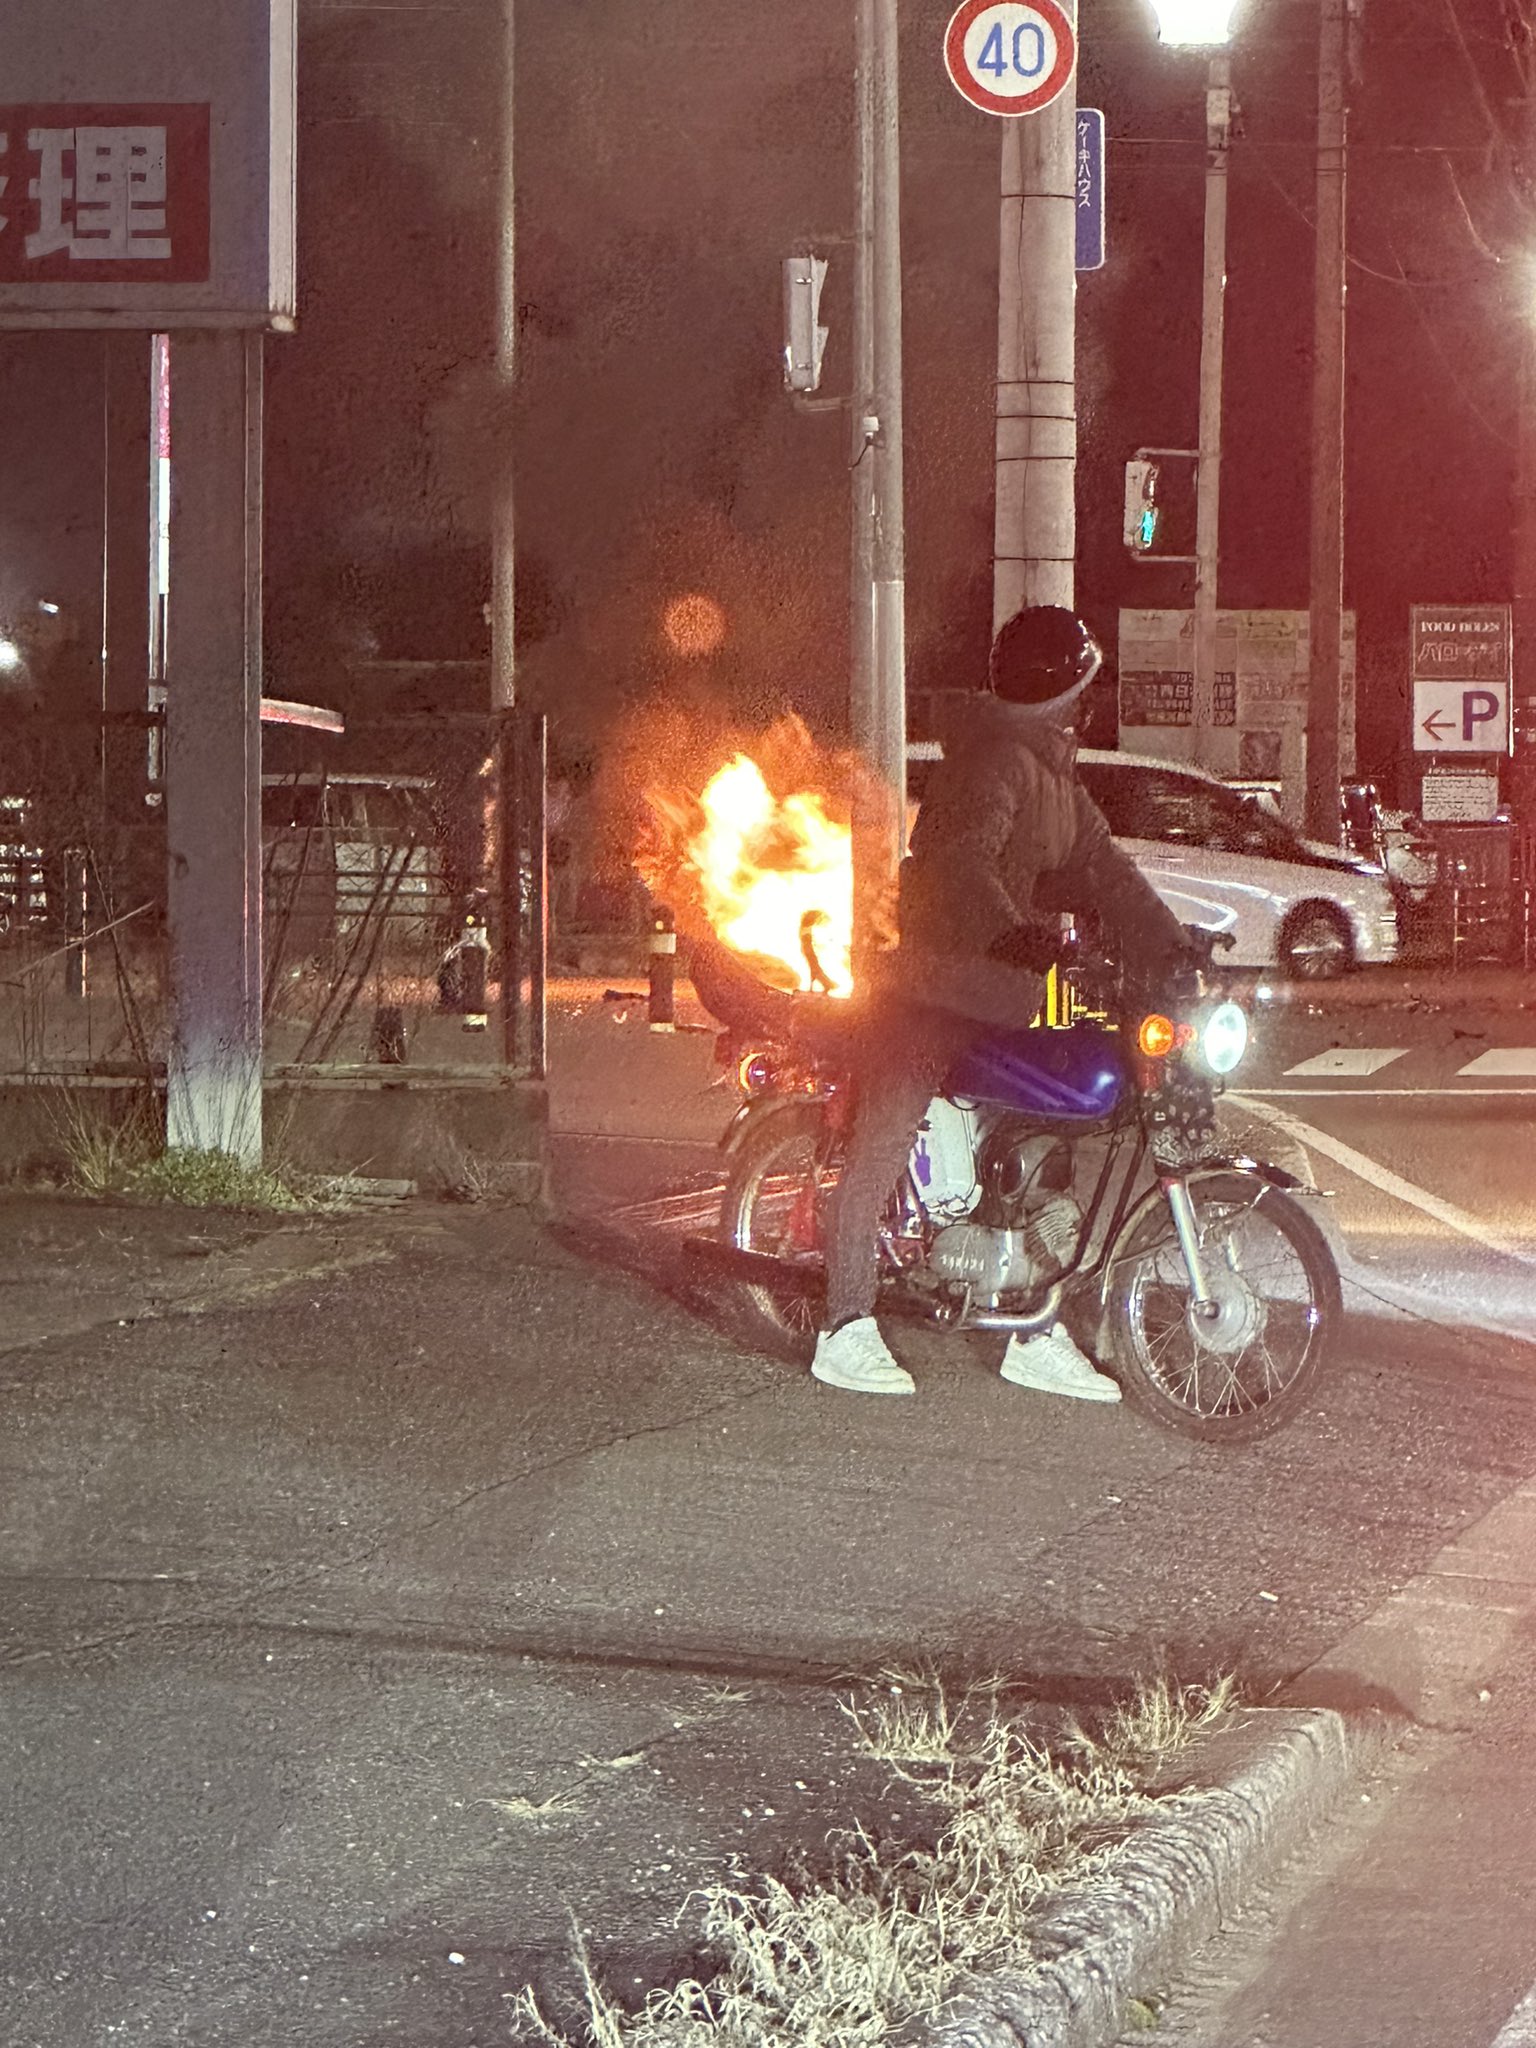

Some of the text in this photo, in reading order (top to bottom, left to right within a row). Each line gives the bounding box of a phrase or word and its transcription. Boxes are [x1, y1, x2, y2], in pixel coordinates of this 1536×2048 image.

[977, 22, 1045, 78] 40
[0, 126, 171, 259] 理
[1077, 119, 1091, 208] ケーキハウス
[1462, 690, 1500, 741] P
